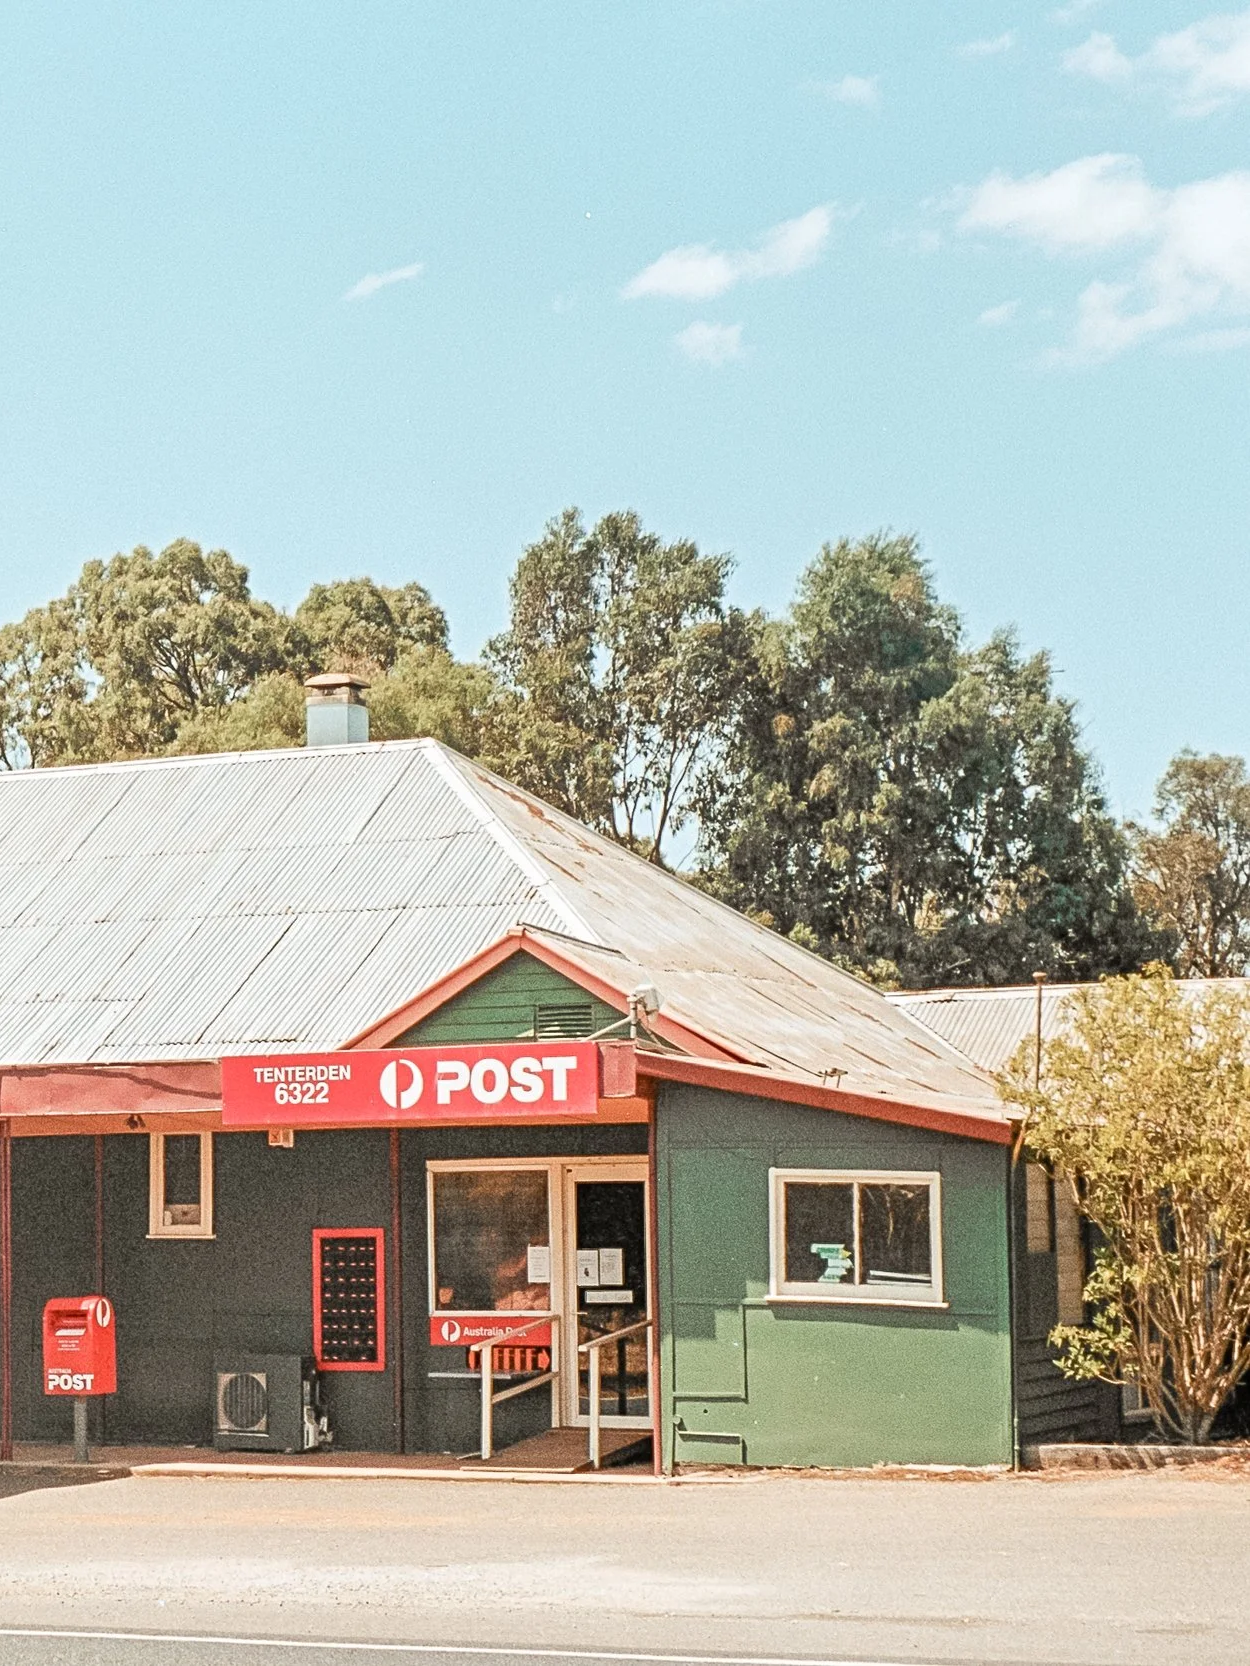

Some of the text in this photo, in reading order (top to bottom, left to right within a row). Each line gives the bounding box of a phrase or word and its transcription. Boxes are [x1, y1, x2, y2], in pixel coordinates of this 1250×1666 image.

[253, 1064, 351, 1083] TENTERDEN
[436, 1056, 578, 1105] POST
[274, 1082, 330, 1105] 6322
[463, 1326, 504, 1337] Australia
[48, 1374, 94, 1390] POST
